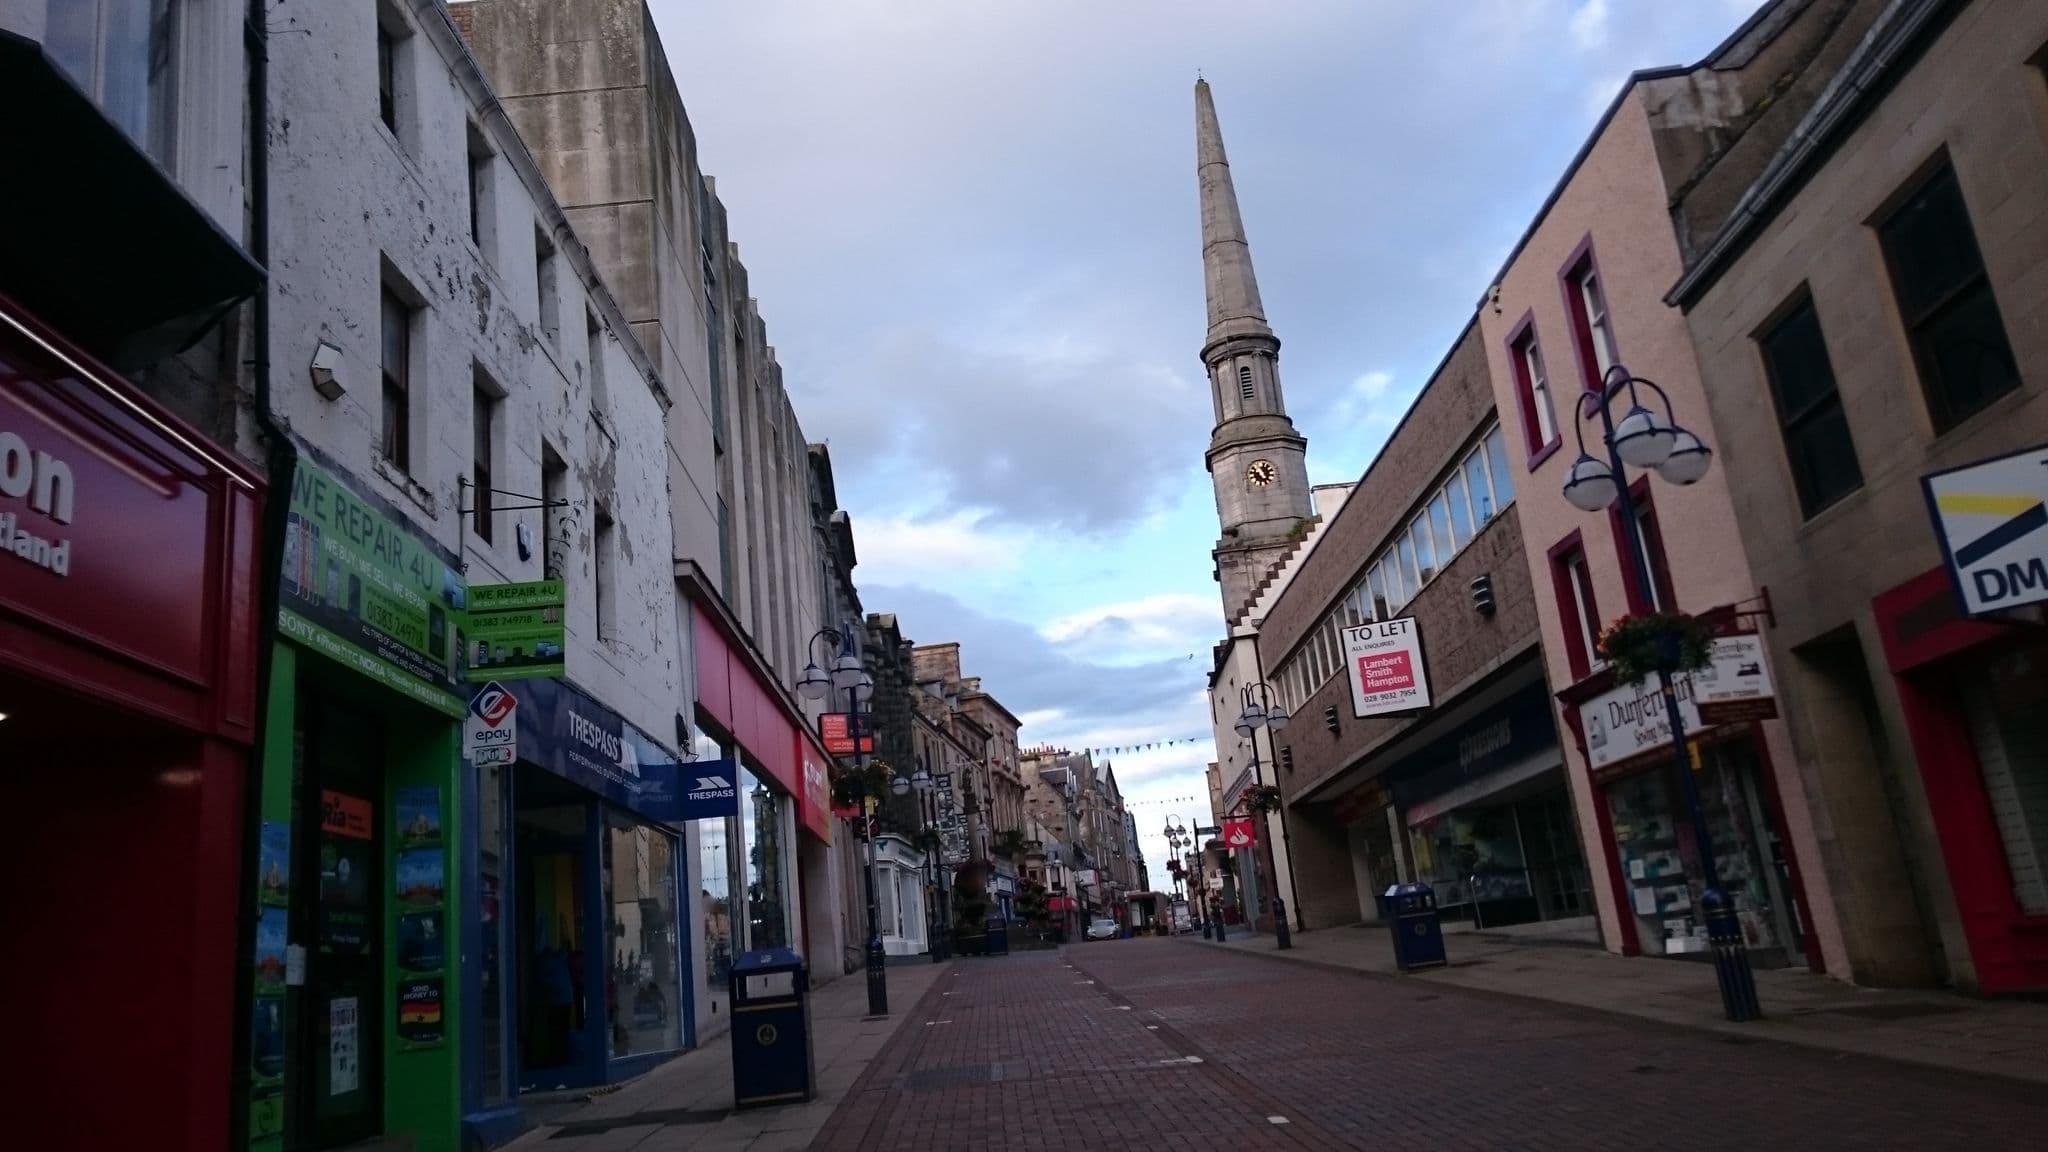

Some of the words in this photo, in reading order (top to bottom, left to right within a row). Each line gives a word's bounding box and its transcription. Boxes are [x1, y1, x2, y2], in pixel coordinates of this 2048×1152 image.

[335, 492, 405, 575] REPAIR
[410, 553, 434, 592] 4U
[474, 590, 494, 601] WE
[497, 586, 537, 600] REPAIR
[541, 584, 558, 597] 4U
[279, 610, 316, 642] SONY
[1349, 628, 1372, 642] TO
[1380, 621, 1408, 637] LET
[1363, 655, 1403, 670] Lambert
[1366, 666, 1393, 679] Smith
[1367, 675, 1409, 689] Hampton
[475, 728, 511, 744] epay
[569, 709, 619, 762] TRESPASS
[688, 788, 735, 801] TRESPASS
